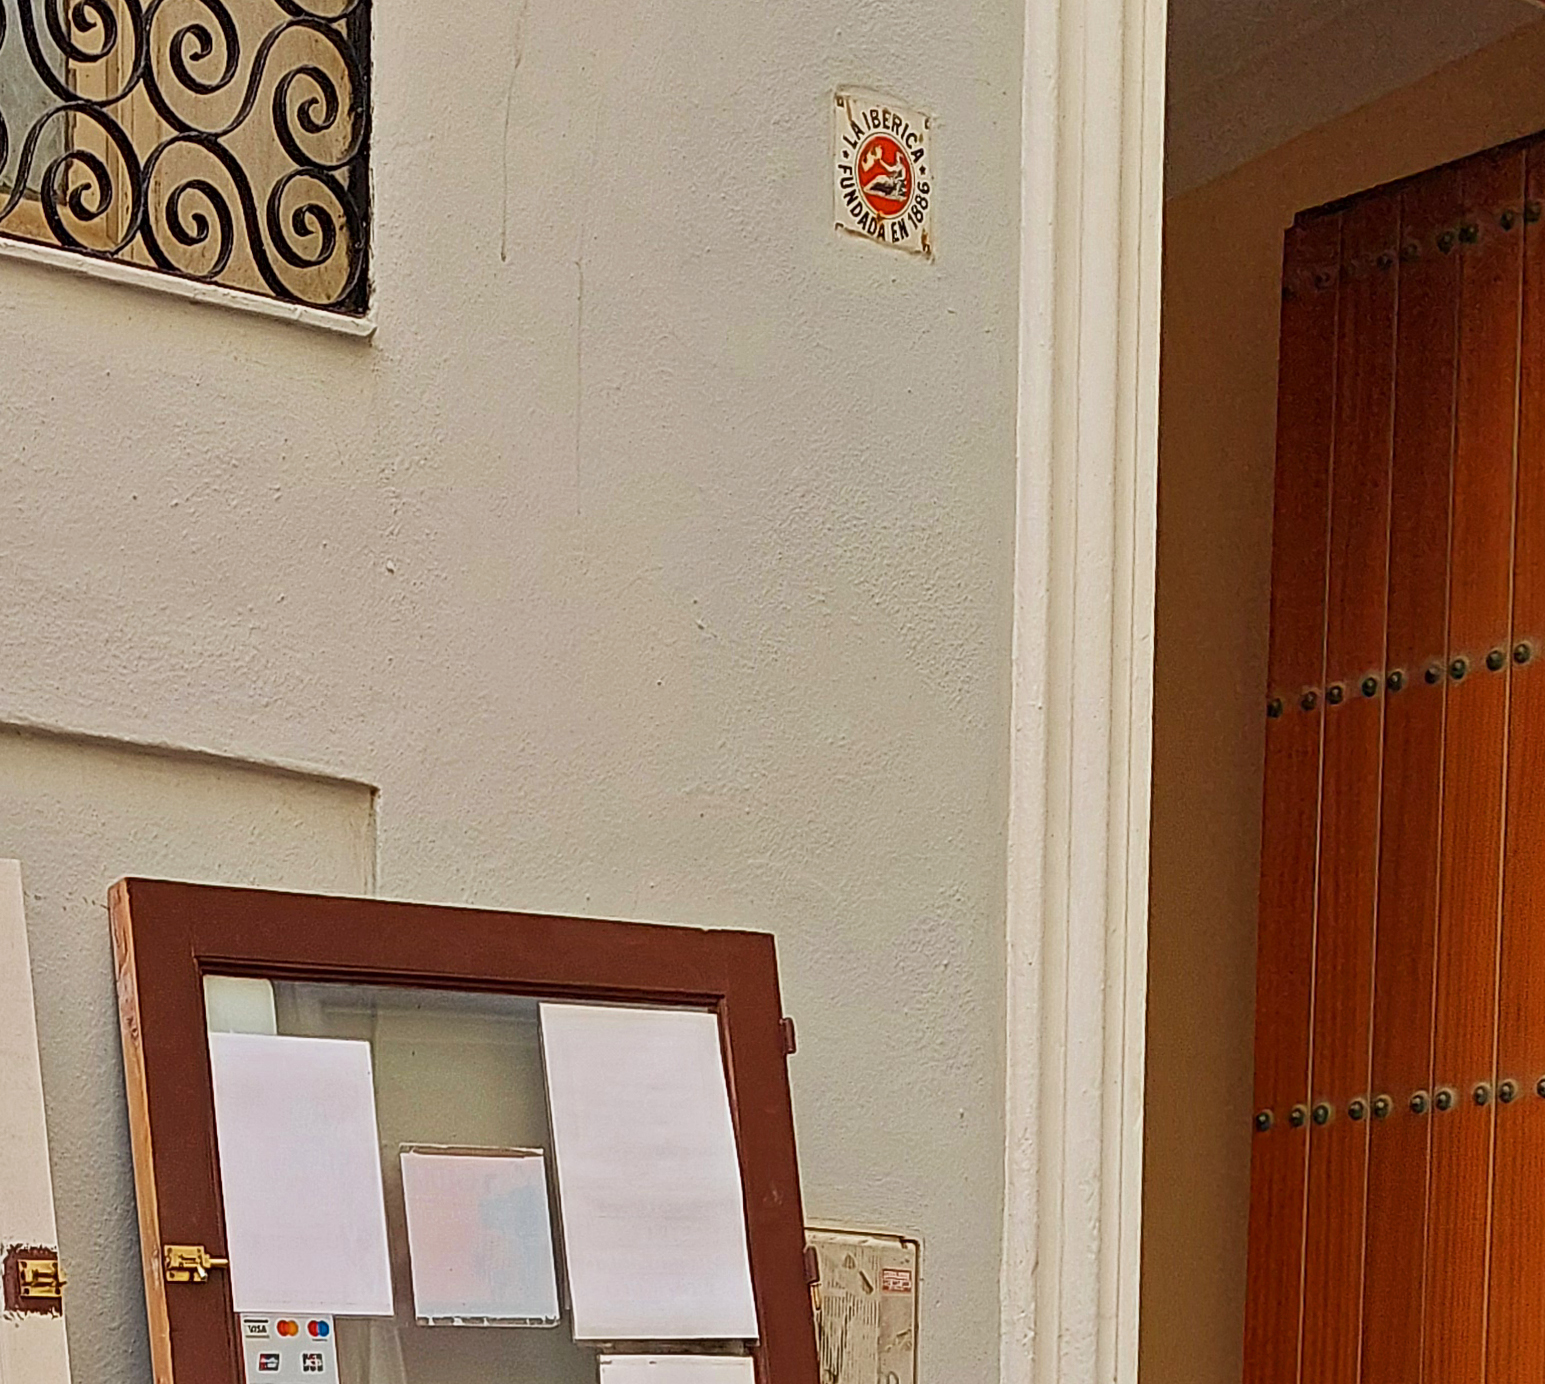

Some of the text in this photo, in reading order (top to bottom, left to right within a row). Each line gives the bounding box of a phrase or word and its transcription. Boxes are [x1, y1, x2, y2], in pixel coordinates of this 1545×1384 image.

[843, 108, 925, 164] LA IBERICA
[838, 164, 931, 243] FUNDADA EN 1886
